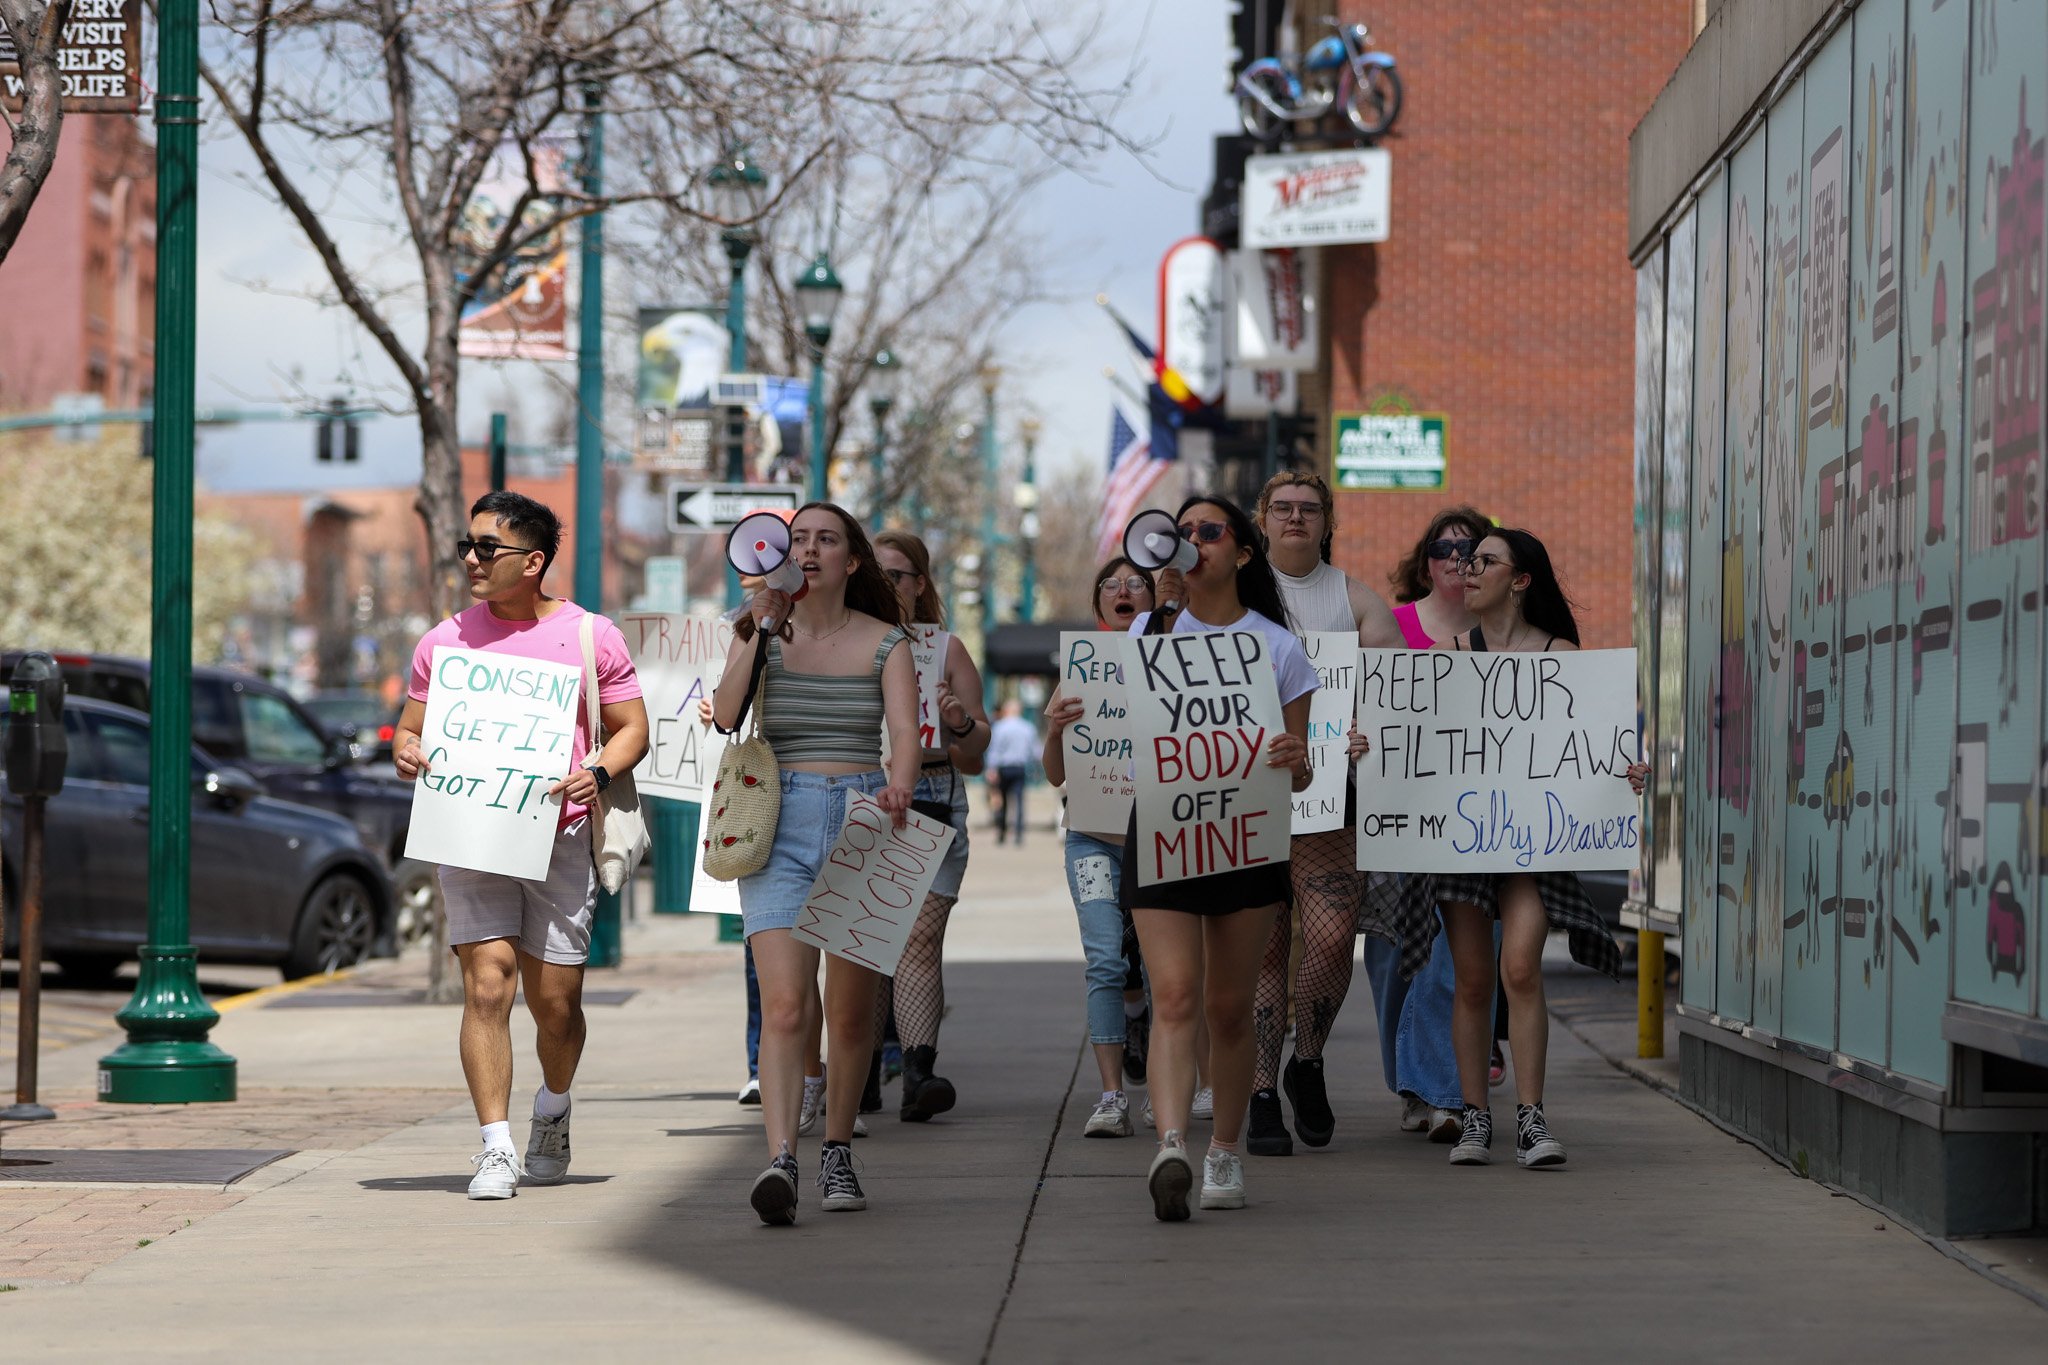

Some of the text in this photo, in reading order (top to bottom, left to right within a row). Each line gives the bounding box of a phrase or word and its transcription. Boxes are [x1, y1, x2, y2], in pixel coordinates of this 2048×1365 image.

[62, 21, 127, 45] VISIT
[4, 74, 126, 97] WDLIFE
[438, 655, 580, 712] CONSENT
[1136, 632, 1261, 692] KEEP
[1313, 665, 1354, 690] GHT
[1362, 652, 1574, 721] KEEP YOUR
[442, 700, 570, 757] GET IT.
[1096, 698, 1126, 720] AND
[1159, 693, 1258, 733] YOUR
[423, 746, 486, 798] GOT
[1109, 765, 1118, 782] 6
[1153, 726, 1265, 783] BODY
[1380, 724, 1636, 780] FILTHY LAWS
[1172, 788, 1240, 822] OFF
[1364, 789, 1638, 868] OFF MY Silky Drawers
[798, 788, 882, 942] MY BODY
[1154, 810, 1269, 880] MINE
[841, 819, 947, 969] MY CHOICE
